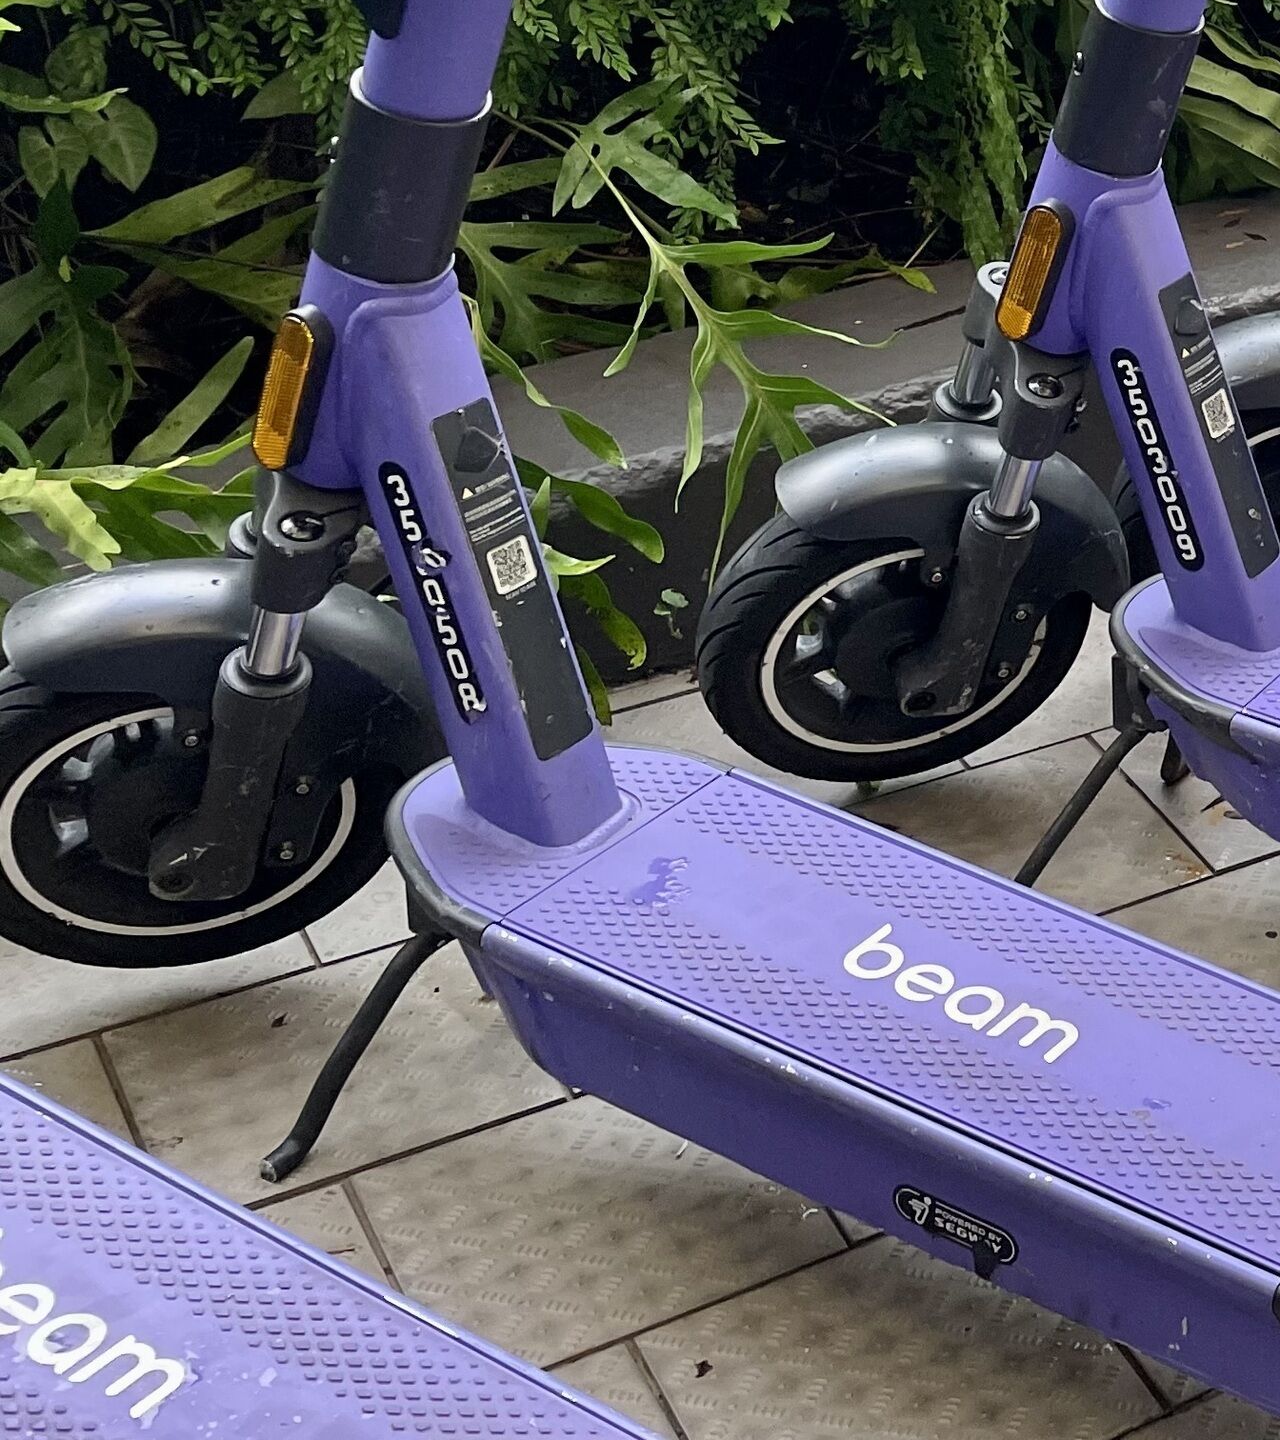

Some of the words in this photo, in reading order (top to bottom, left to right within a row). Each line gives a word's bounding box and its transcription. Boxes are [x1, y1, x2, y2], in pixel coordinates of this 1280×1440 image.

[1117, 359, 1197, 561] 3503009
[843, 923, 1079, 1064] beam
[934, 1207, 986, 1237] POWERED
[988, 1231, 1002, 1243] BY
[0, 1228, 186, 1419] eam
